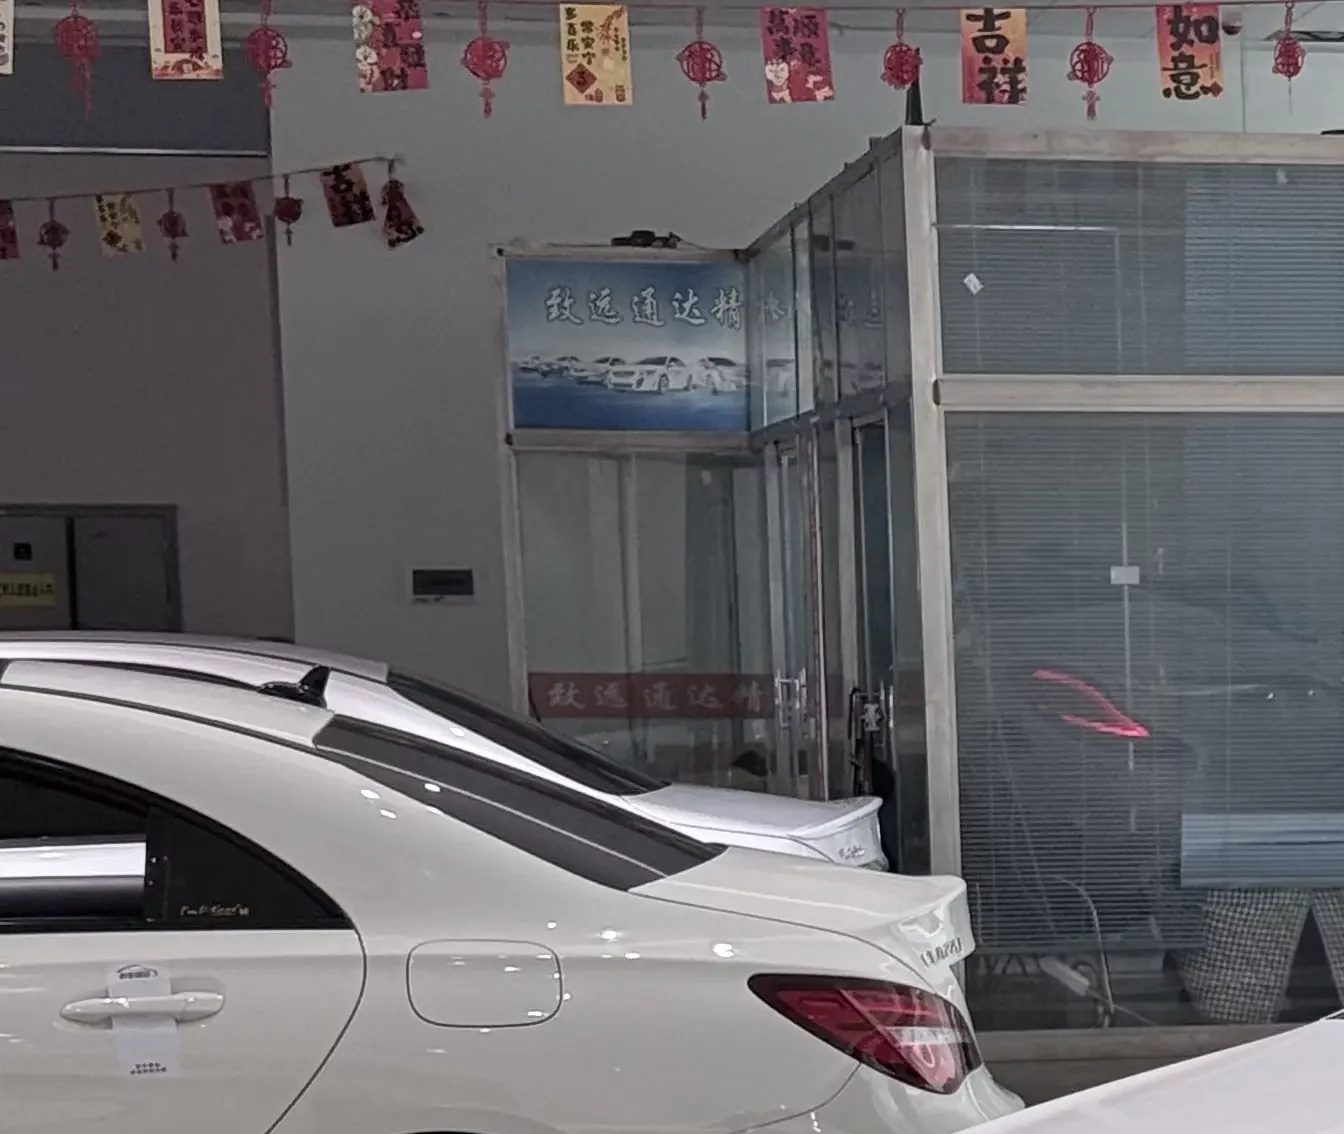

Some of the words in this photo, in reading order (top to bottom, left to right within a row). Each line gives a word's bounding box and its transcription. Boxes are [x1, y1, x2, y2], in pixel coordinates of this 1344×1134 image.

[966, 8, 1027, 104] 吉祥
[1161, 6, 1218, 100] 如意
[544, 285, 745, 332] 致远通达精
